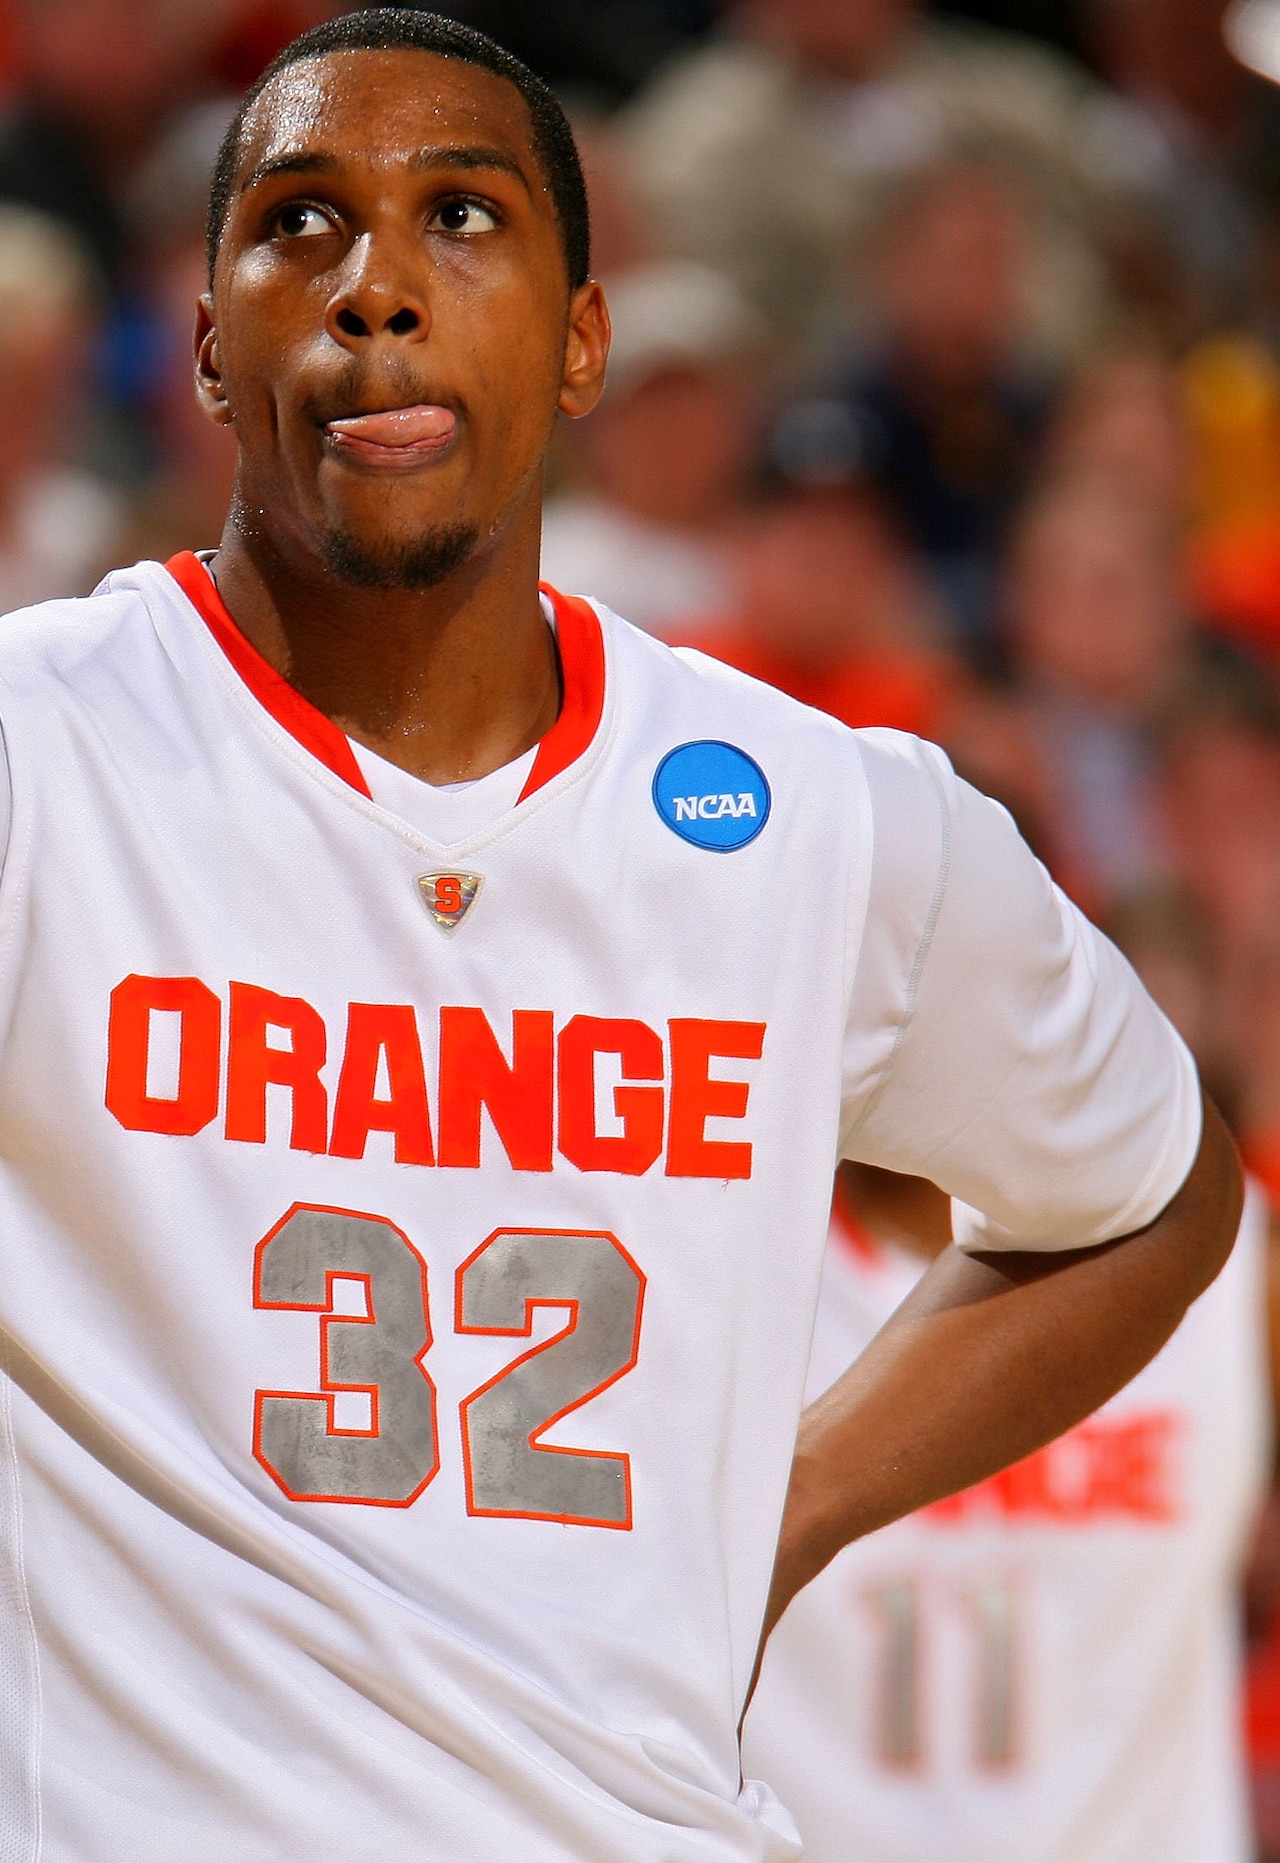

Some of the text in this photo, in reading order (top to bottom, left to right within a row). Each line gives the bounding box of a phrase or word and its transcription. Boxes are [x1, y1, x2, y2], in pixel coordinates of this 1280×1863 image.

[434, 876, 462, 914] S
[672, 792, 758, 822] NCAA
[105, 973, 768, 1180] ORANGE
[252, 1201, 648, 1531] 32
[858, 1570, 1030, 1778] 11
